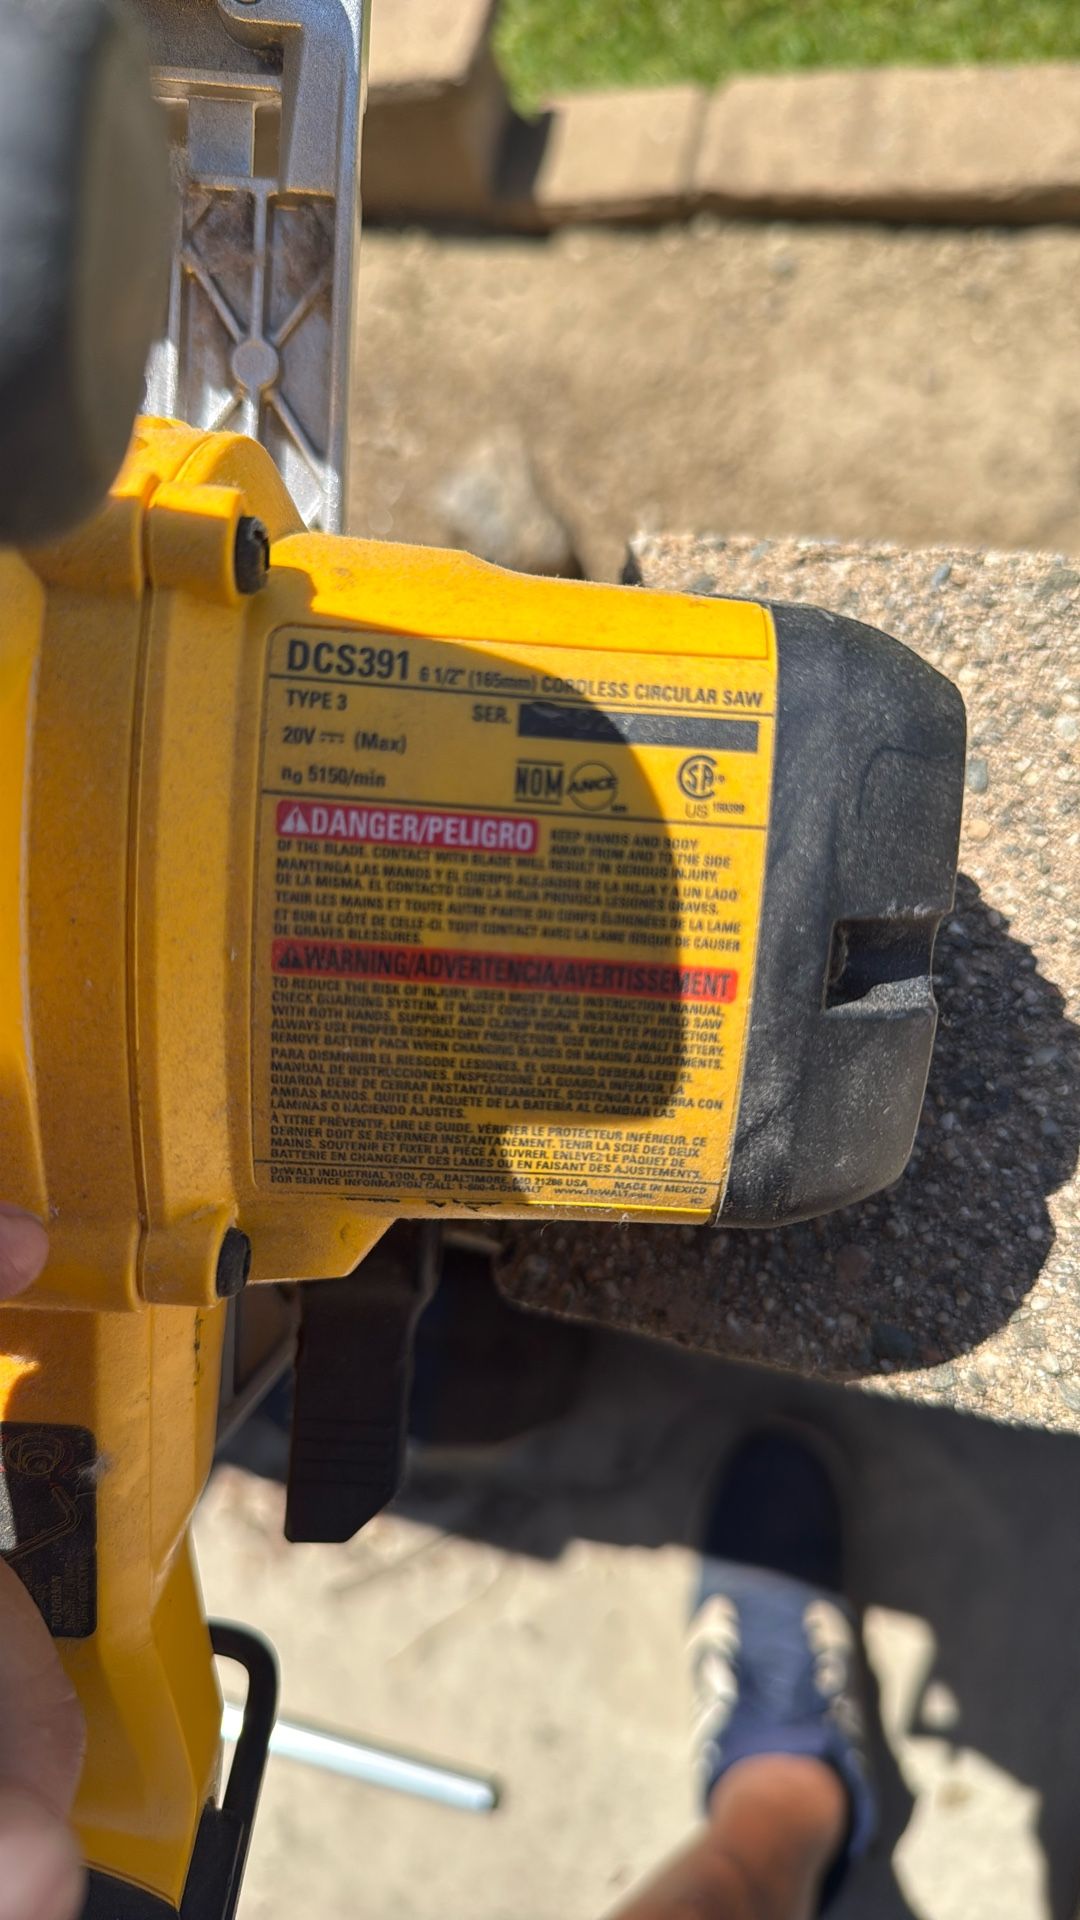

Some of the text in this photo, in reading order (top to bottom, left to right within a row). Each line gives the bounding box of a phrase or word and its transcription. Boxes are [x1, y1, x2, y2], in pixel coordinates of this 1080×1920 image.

[286, 639, 409, 680] DCS391
[541, 675, 632, 699] CORDLESS
[635, 682, 720, 705] CIRCULAR
[723, 689, 763, 709] SAW
[285, 689, 347, 711] TYPE 3
[471, 704, 511, 724] SER.
[282, 724, 407, 755] 20V (Max)
[516, 766, 562, 799] NOM
[312, 807, 533, 850] DANGER/PELIGRO
[704, 887, 738, 901] LADO
[304, 948, 731, 996] WARNING/ADVERTENCIA/AVERTISSEMENT
[270, 1018, 321, 1031] ALWAYS
[693, 1017, 722, 1029] SAW
[270, 1047, 305, 1059] PARA
[270, 1061, 324, 1073] MANUAL
[328, 1064, 344, 1074] DE
[270, 1073, 322, 1086] GUARDA
[360, 1079, 377, 1089] DE
[696, 1098, 723, 1109] CON
[270, 1086, 317, 1098] AMBAS
[428, 1095, 482, 1107] PAQUETE
[652, 1107, 676, 1118] LAS
[330, 1102, 340, 1112] O
[342, 1102, 406, 1115] HACIENDO
[270, 1125, 322, 1137] DERNIER
[325, 1128, 353, 1138] DOIT
[356, 1129, 372, 1139] SE
[374, 1130, 438, 1143] REFERMER
[559, 1140, 593, 1151] TENIR
[594, 1142, 610, 1152] LA
[613, 1143, 639, 1153] SCIE
[641, 1144, 666, 1155] DES
[283, 1114, 315, 1125] TITRE
[389, 1120, 414, 1130] LIRE
[417, 1121, 431, 1131] LE
[530, 1127, 544, 1137] LE
[546, 1128, 623, 1141] PROTECTEUR
[691, 1136, 708, 1146] CE
[270, 1148, 326, 1159] BATTERIE
[329, 1151, 347, 1160] EN
[349, 1152, 423, 1164] CHANGEANT
[426, 1156, 450, 1165] DES
[452, 1157, 493, 1167] LAMES
[496, 1159, 513, 1168] OU
[516, 1160, 532, 1169] EN
[535, 1161, 585, 1172] FAISANT
[587, 1163, 611, 1173] DES
[318, 1139, 379, 1151] SOUTENIR
[381, 1142, 395, 1151] ET
[434, 1145, 449, 1154] LA
[604, 1154, 619, 1163] LE
[621, 1155, 668, 1165] PAQUET
[670, 1157, 685, 1166] DE
[269, 1175, 292, 1183] FOR
[294, 1176, 340, 1185] SERVICE
[343, 1178, 422, 1189] INFORMATION
[317, 1168, 383, 1178] INDUSTRIAL
[564, 1179, 588, 1188] USA
[613, 1182, 707, 1194] MADE IN MEXICO
